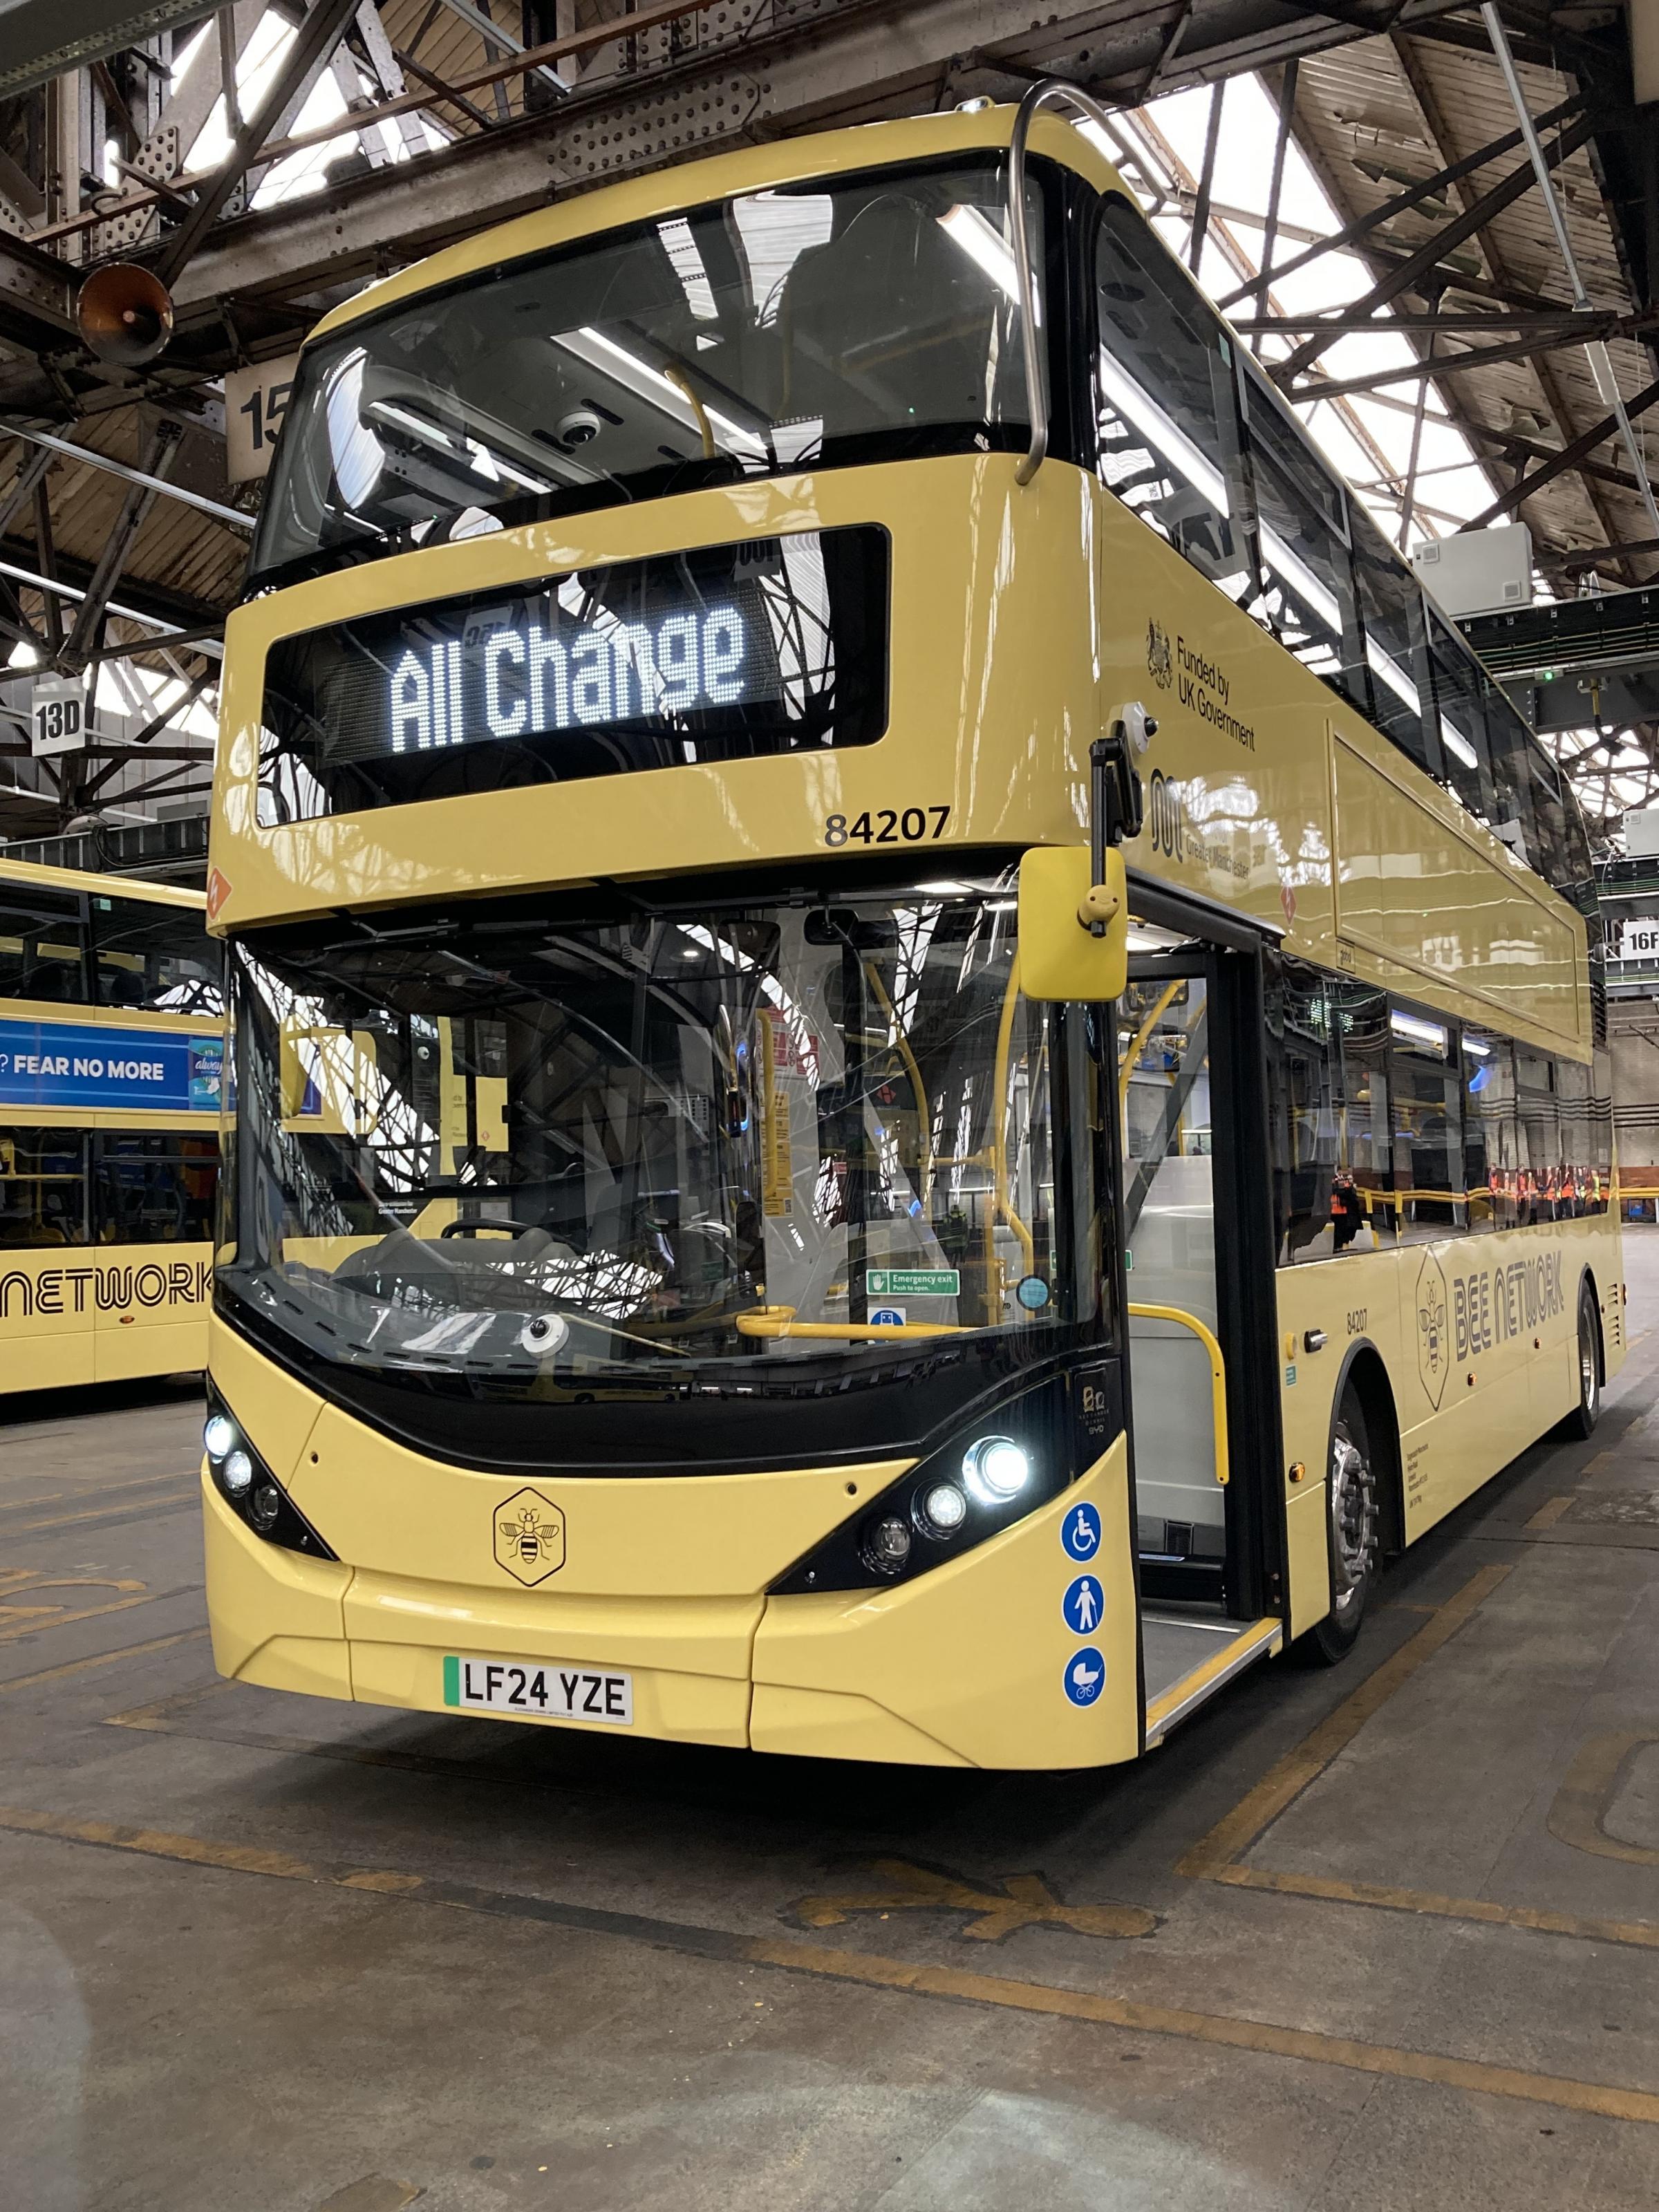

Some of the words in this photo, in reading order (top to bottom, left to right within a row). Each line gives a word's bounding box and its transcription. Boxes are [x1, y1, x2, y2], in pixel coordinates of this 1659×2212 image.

[391, 640, 464, 753] All
[485, 606, 745, 738] Change
[1177, 635, 1215, 690] Funded
[1217, 667, 1229, 705] by
[36, 700, 79, 741] 13D
[1179, 673, 1195, 711] UK
[1197, 688, 1255, 752] Government
[825, 805, 950, 847] 84207
[1186, 834, 1212, 863] Greater
[1213, 847, 1249, 880] Manchester
[1629, 931, 1658, 950] 16F
[14, 1054, 69, 1076] FEAR
[73, 1058, 104, 1078] NO
[108, 1060, 164, 1080] MORE
[195, 1057, 223, 1075] alway
[892, 1275, 936, 1285] Emergency
[937, 1275, 953, 1283] exit
[1347, 1308, 1367, 1335] 84207
[1454, 1271, 1492, 1362] BEE
[1494, 1250, 1564, 1344] NETWORK
[1088, 1425, 1104, 1435] BYD
[465, 1663, 549, 1707] LF24
[560, 1673, 626, 1716] YZE
